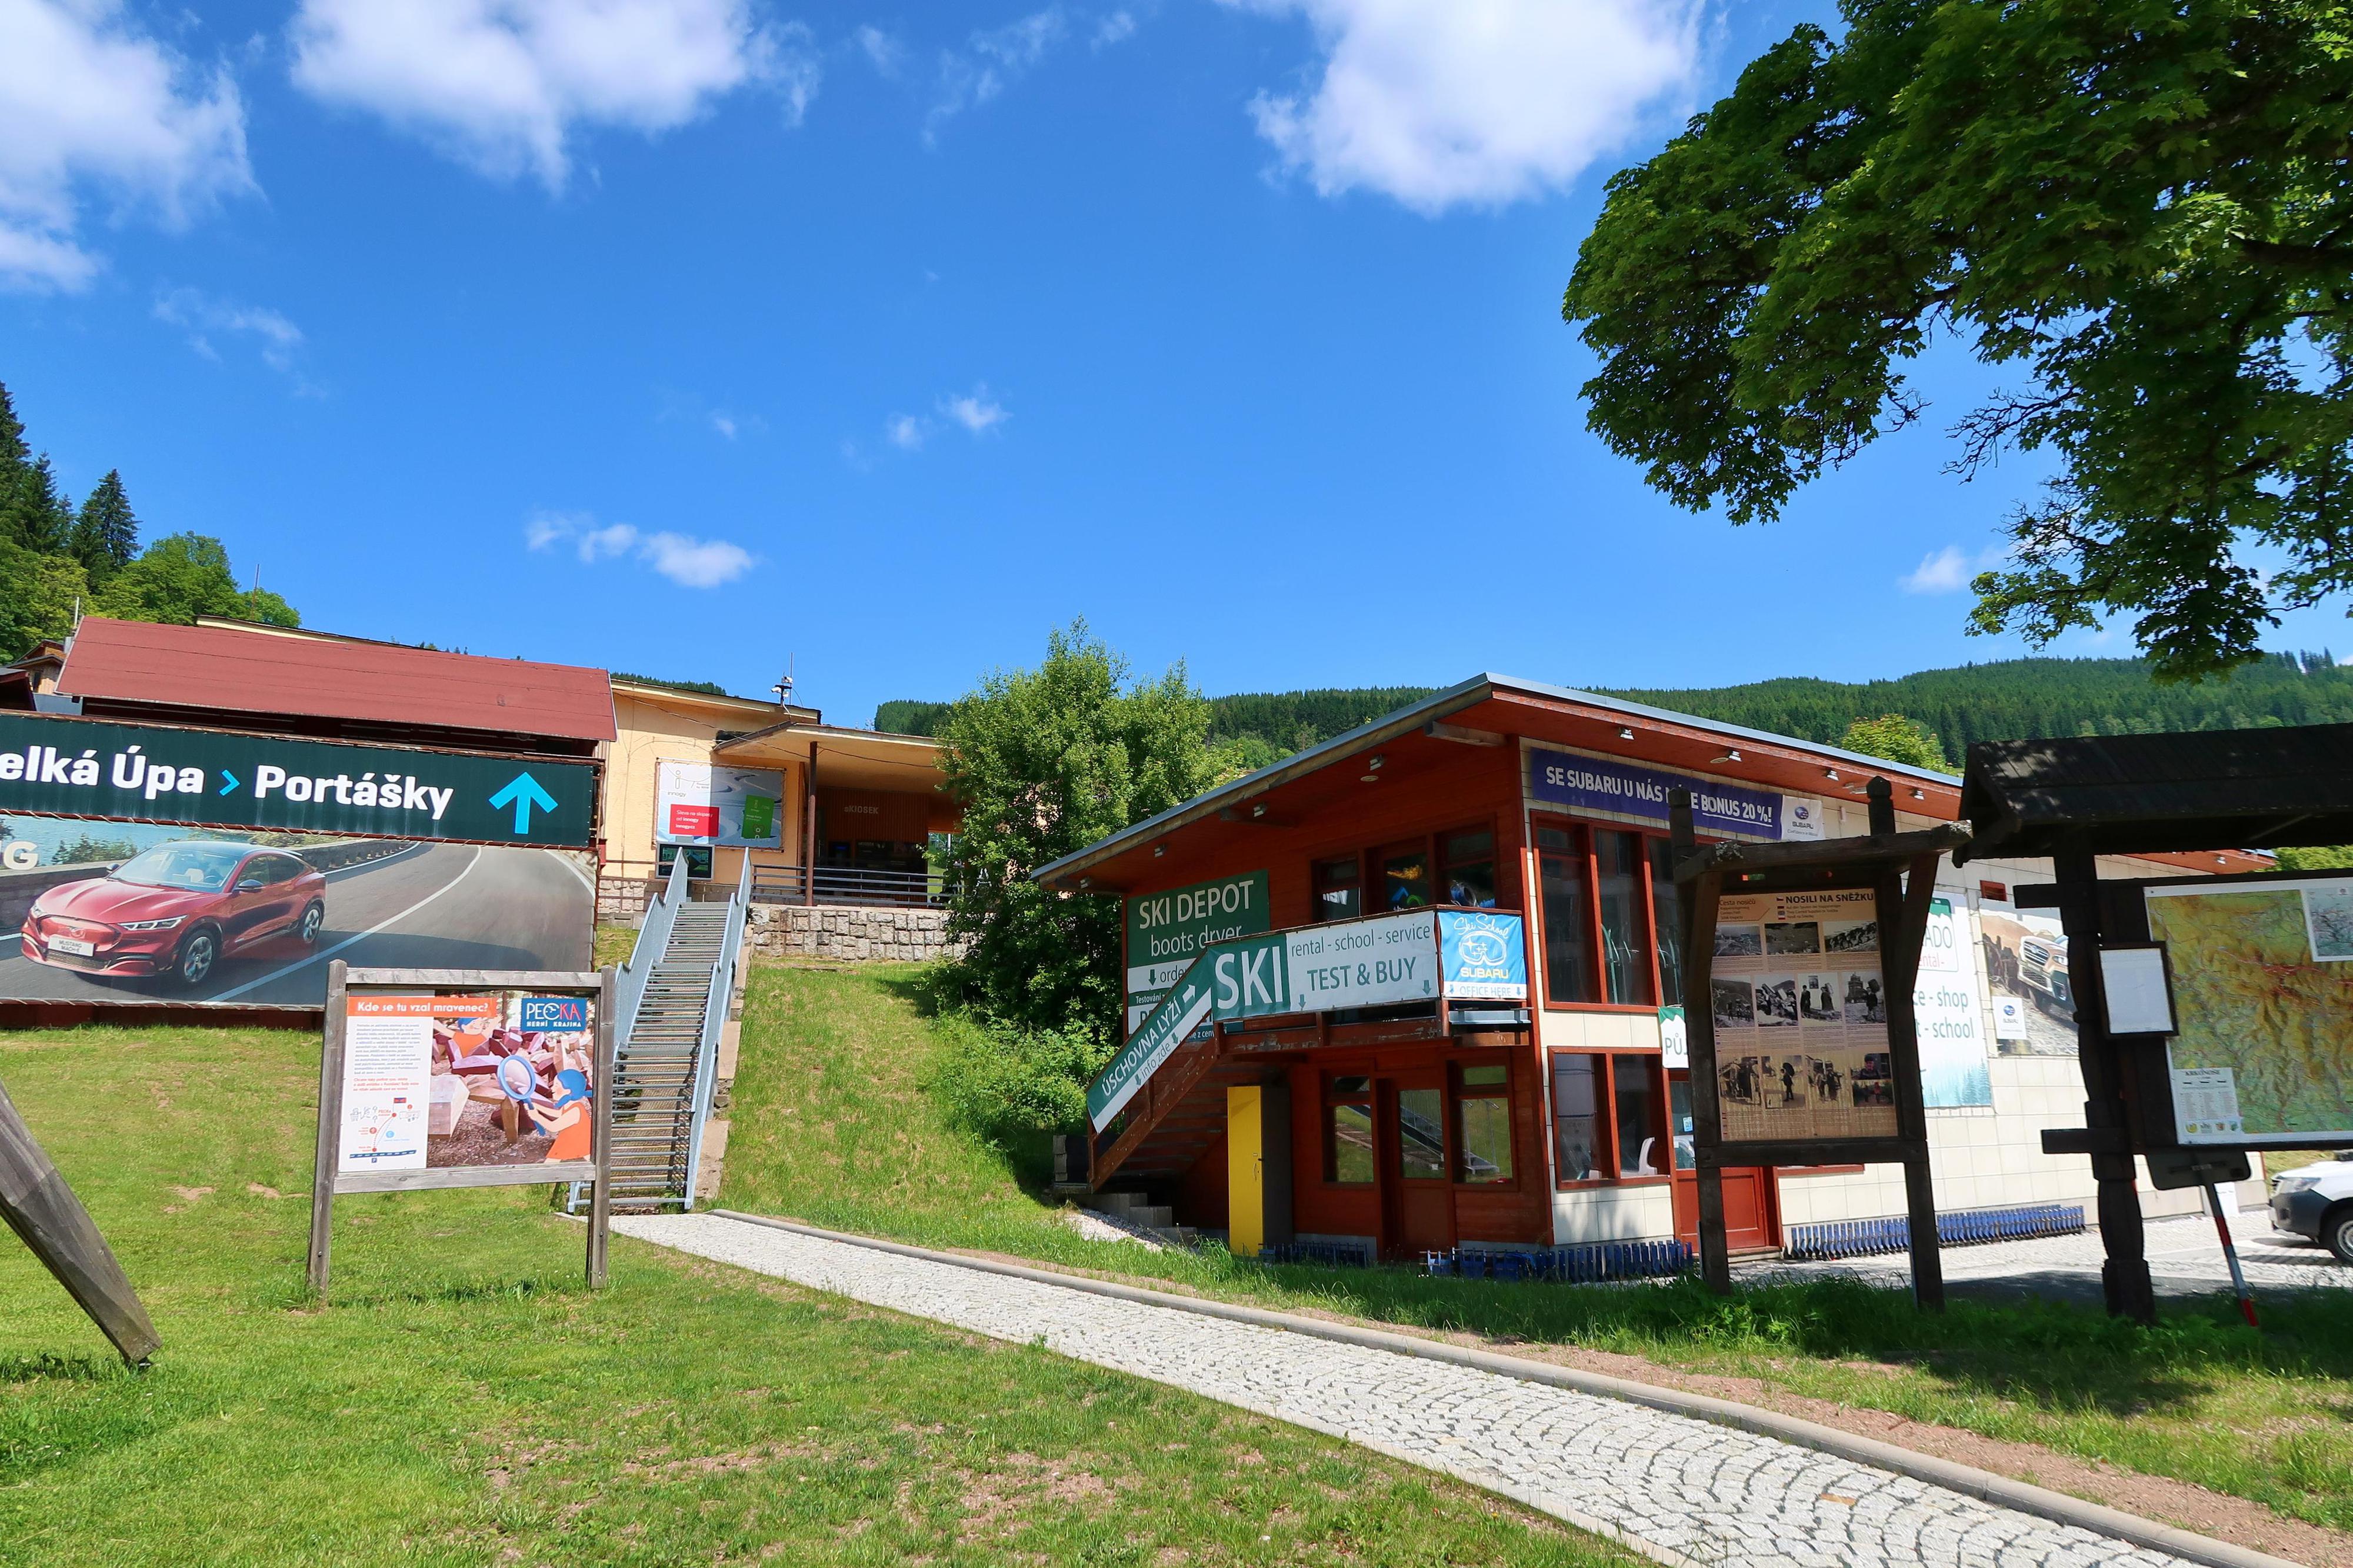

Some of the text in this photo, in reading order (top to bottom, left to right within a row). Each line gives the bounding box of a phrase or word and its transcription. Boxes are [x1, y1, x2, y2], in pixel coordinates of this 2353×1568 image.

[0, 745, 454, 820] elká Úpa Portášky
[1546, 766, 1565, 786] SE
[1567, 769, 1621, 795] SUBARU
[1624, 779, 1633, 798] U
[1636, 778, 1663, 803] NÁS
[1701, 794, 1740, 817] BONUS
[1742, 802, 1755, 819] 20
[1139, 880, 1254, 929] SKI DEPOT
[1785, 895, 1817, 904] NOSILI
[1836, 892, 1874, 902] SNĚŽKU
[1454, 913, 1509, 939] Ski School
[1923, 925, 1952, 948] ADO
[1151, 931, 1194, 956] boots
[1291, 936, 1324, 958] rental
[1335, 929, 1374, 952] school
[1386, 923, 1431, 944] service
[1160, 965, 1187, 983] orde
[1215, 946, 1284, 1010] SKI
[1307, 956, 1417, 992] TEST & BUY
[1459, 967, 1509, 979] SUBARU
[1459, 986, 1511, 997] OFFICE HERE
[1937, 985, 1968, 1013] shop
[357, 1002, 379, 1012] Kde
[397, 1003, 406, 1012] tu
[410, 1003, 430, 1012] vzal
[434, 1002, 489, 1012] mravenec?
[526, 1002, 582, 1021] PECKA
[1932, 1016, 1975, 1039] school
[1102, 996, 1182, 1096] ÚSCHOVNA LYŽÍ
[1665, 1032, 1687, 1056] PŮ
[1141, 1043, 1171, 1079] info zde
